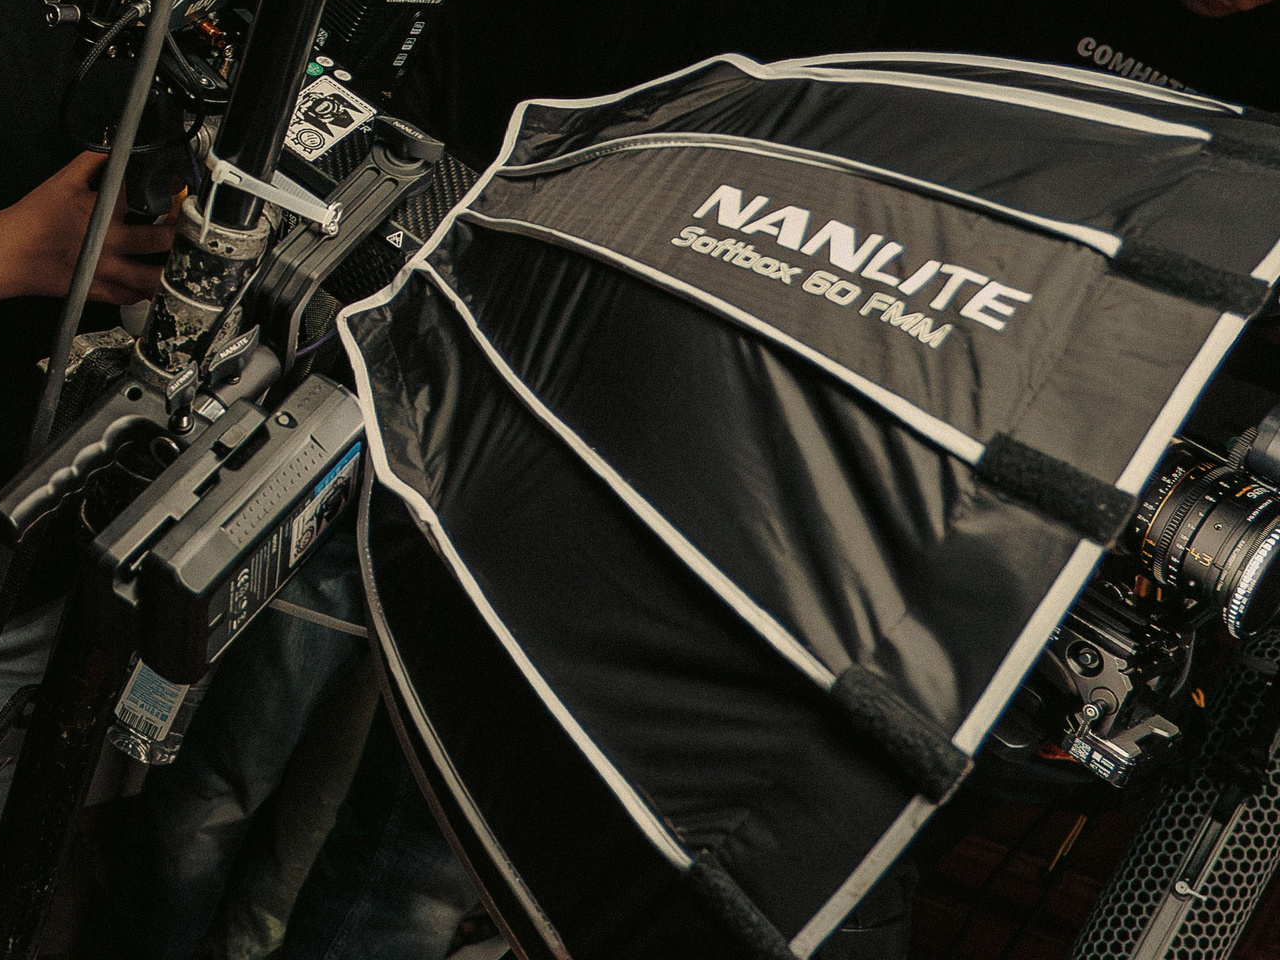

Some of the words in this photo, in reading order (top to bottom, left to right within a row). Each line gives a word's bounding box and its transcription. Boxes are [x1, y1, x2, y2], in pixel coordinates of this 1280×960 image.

[392, 120, 425, 140] NANLITE
[671, 225, 804, 285] Softbox
[801, 270, 862, 307] 60
[859, 291, 954, 349] FMM
[692, 184, 1033, 332] NANLITE
[219, 337, 249, 359] NANLITE
